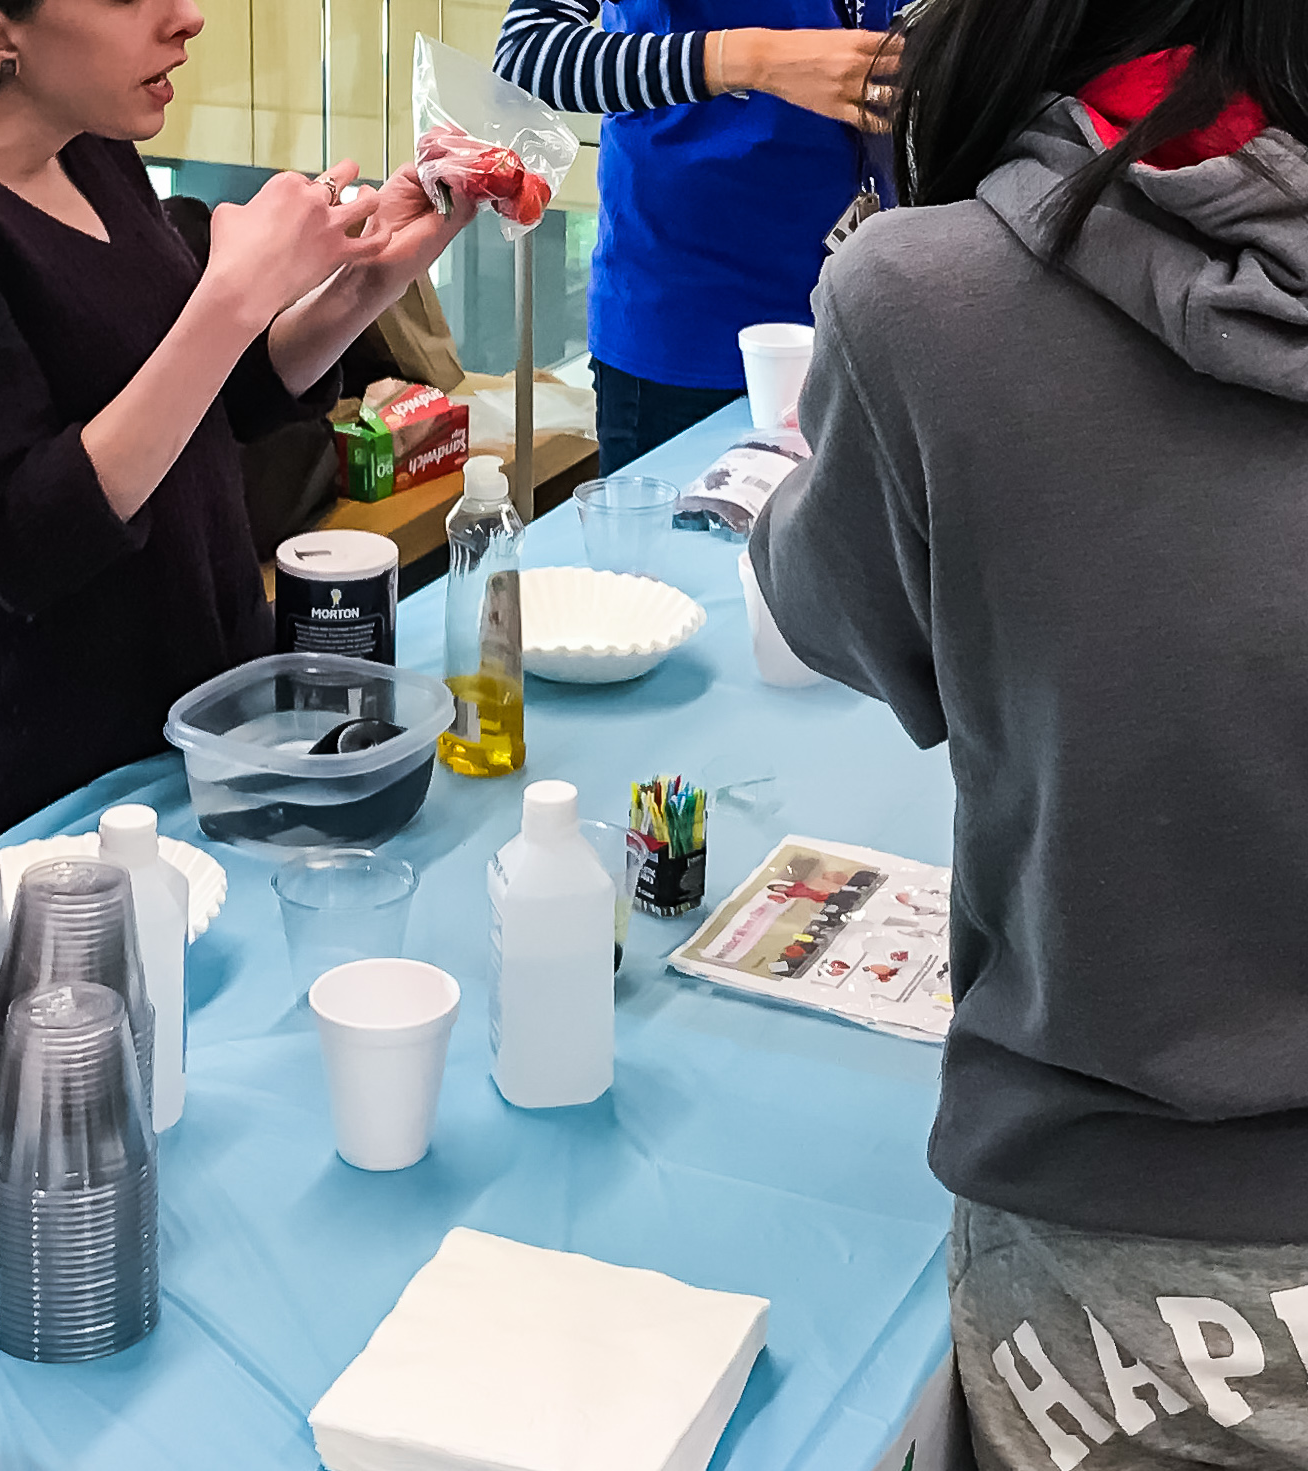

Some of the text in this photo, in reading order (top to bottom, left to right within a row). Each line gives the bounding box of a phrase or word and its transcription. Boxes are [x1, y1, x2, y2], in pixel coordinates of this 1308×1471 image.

[391, 384, 444, 417] andwich
[409, 439, 467, 476] Sandwich
[311, 607, 360, 620] MORTON
